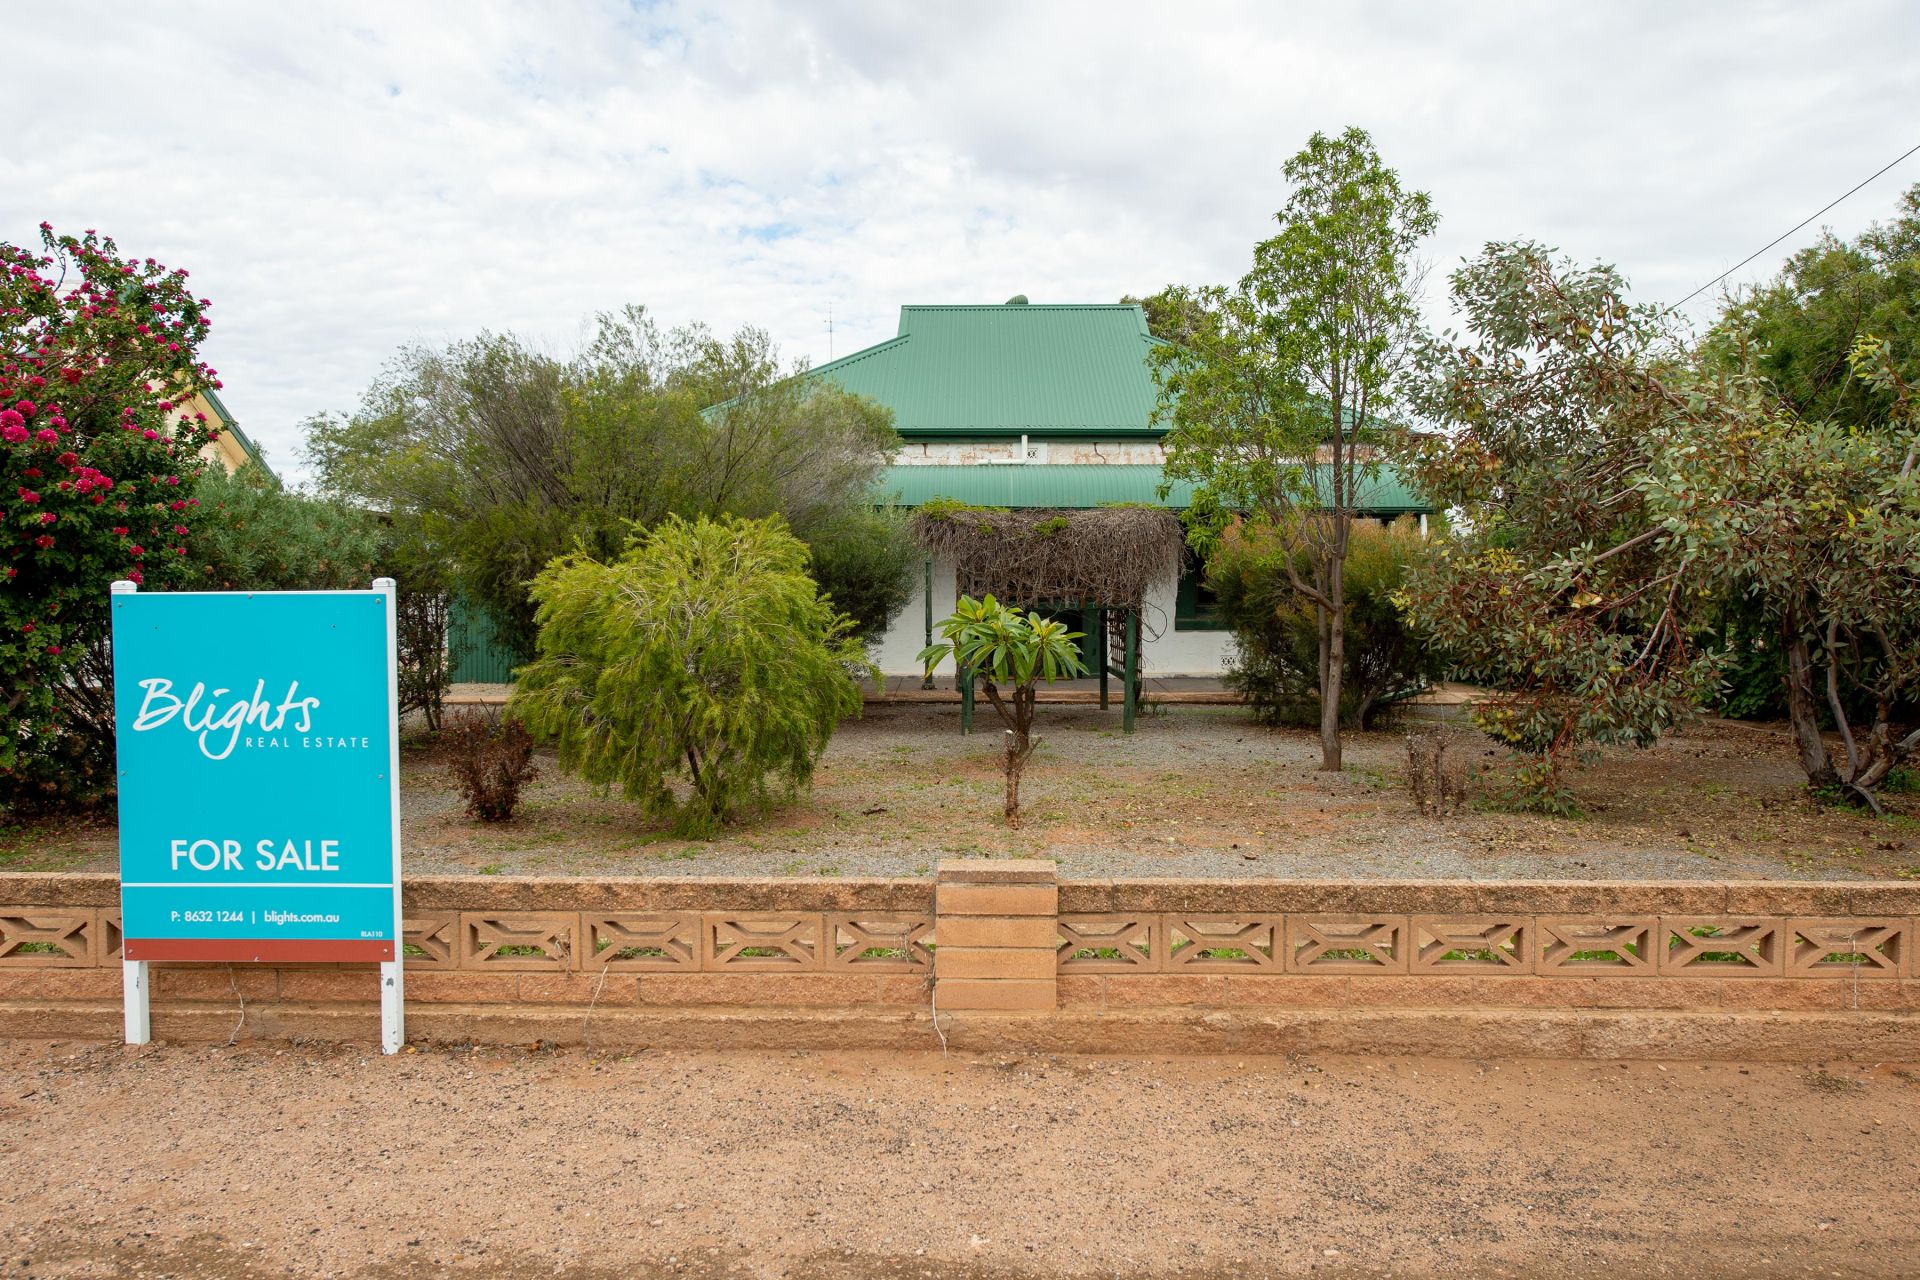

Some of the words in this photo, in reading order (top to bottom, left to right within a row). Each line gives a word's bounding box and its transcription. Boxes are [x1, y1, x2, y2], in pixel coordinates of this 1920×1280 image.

[132, 677, 321, 761] Blights
[245, 737, 289, 748] REAL
[303, 737, 369, 748] ESTATE
[170, 839, 244, 871] FOR
[255, 839, 340, 872] SALE
[170, 910, 181, 922] P:
[184, 910, 213, 922] 8632
[216, 910, 244, 922] 1244
[264, 910, 340, 926] blights.com.au
